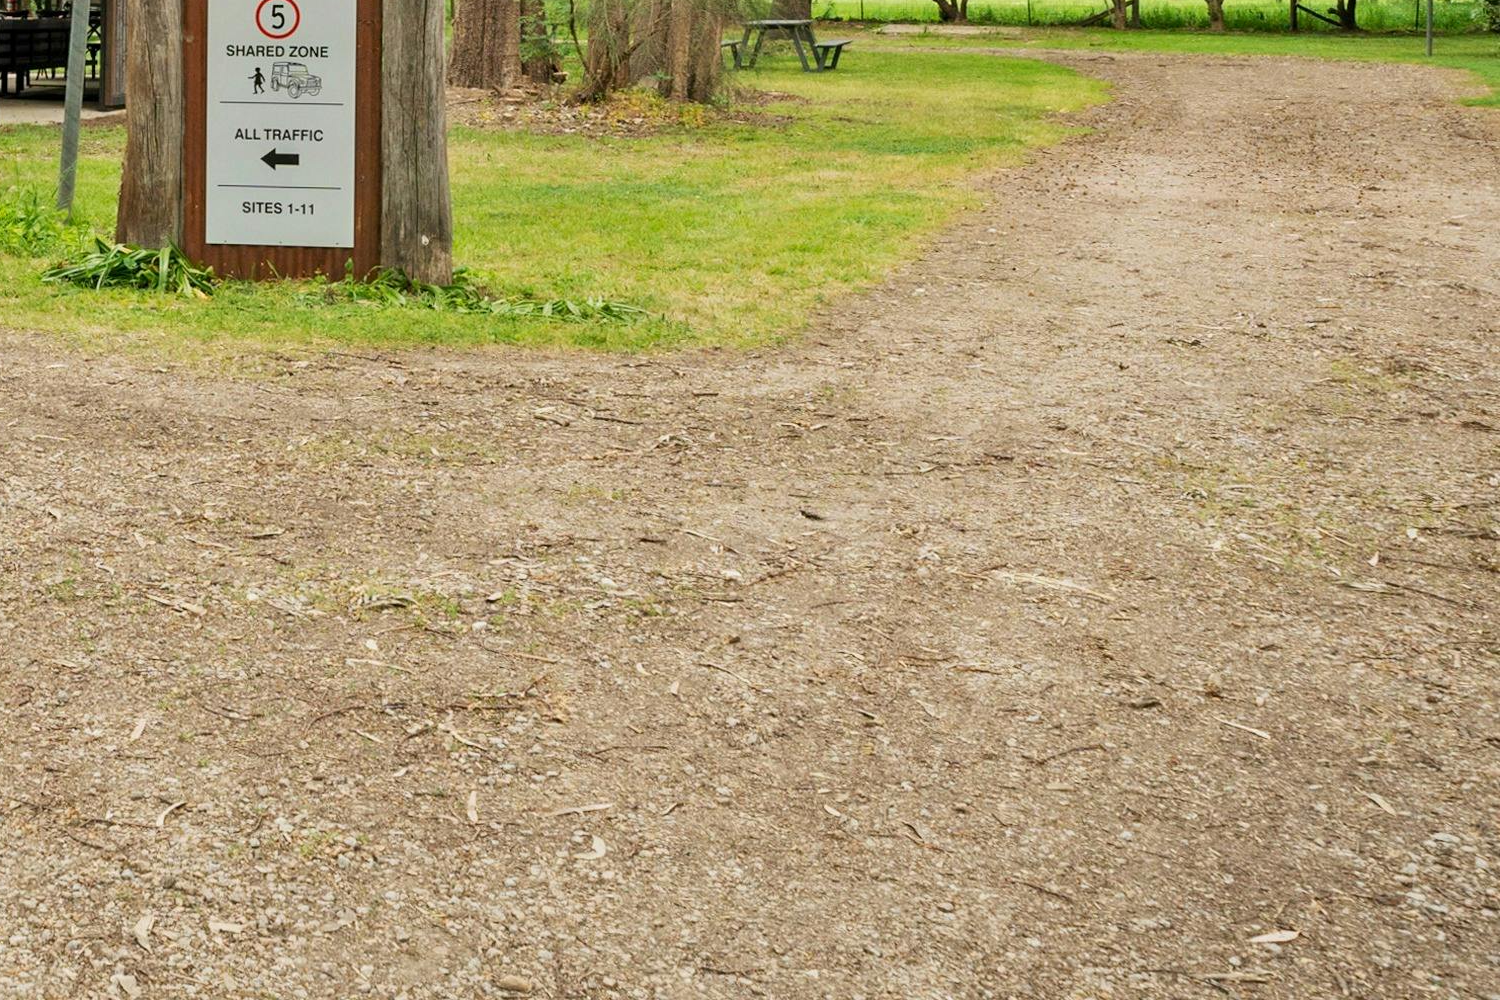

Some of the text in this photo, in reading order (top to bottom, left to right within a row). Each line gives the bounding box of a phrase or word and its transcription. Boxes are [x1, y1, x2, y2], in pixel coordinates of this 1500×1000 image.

[271, 4, 285, 29] 5
[226, 44, 329, 58] SHARED ZONE
[234, 128, 324, 142] ALL TRAFFIC
[242, 201, 315, 215] SITES 1-11
